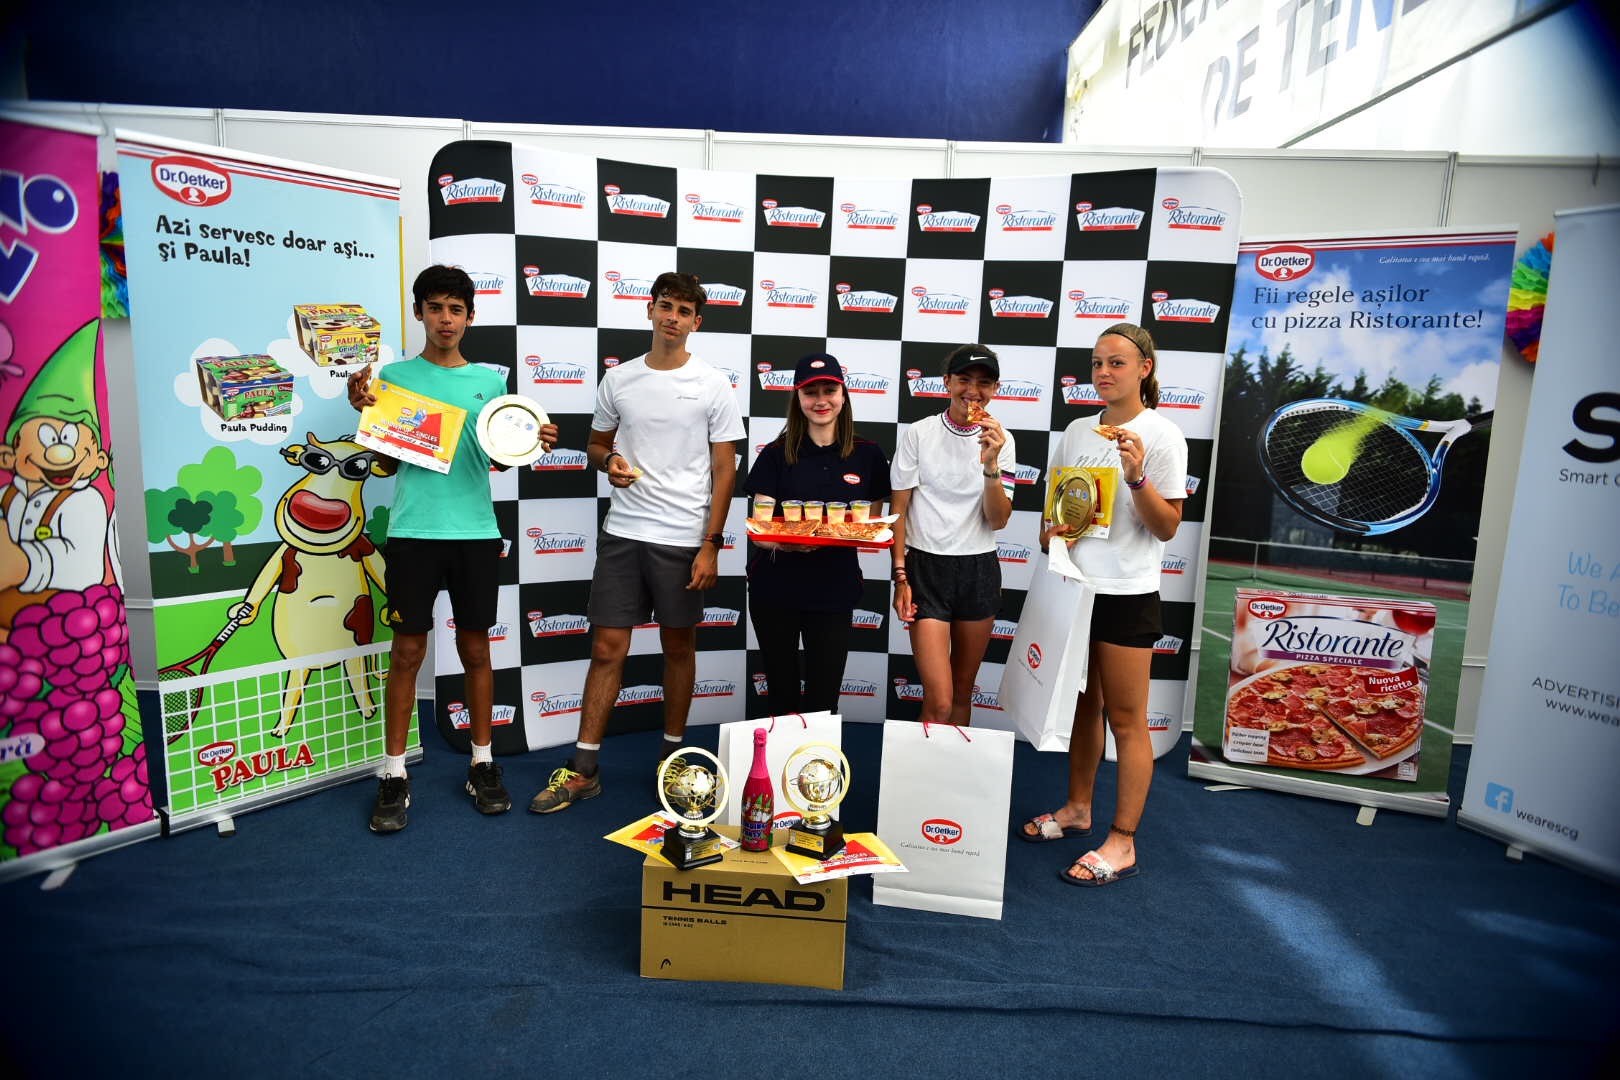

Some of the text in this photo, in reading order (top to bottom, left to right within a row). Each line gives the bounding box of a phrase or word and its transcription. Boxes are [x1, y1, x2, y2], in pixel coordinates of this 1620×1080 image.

[160, 168, 226, 190] Dr.Oetker
[445, 182, 502, 200] Ristorante
[529, 184, 586, 204] Ristorante
[611, 194, 667, 213] Ristorante
[691, 202, 744, 219] Ristorante
[768, 207, 822, 223] Ristorante
[846, 211, 899, 226] Ristorante
[921, 213, 976, 228] Ristorante
[1000, 213, 1056, 229] Ristorante
[1081, 211, 1140, 226] Ristorante
[1167, 209, 1226, 226] Ristorante
[156, 214, 191, 236] Azi
[199, 223, 276, 247] servesc
[282, 229, 327, 253] doar
[184, 242, 251, 267] Paula!
[1260, 255, 1310, 268] Dr.Oetker
[529, 276, 586, 296] Ristorante
[612, 280, 652, 297] Ristora
[706, 287, 743, 302] torante
[765, 288, 817, 304] Ristorante
[842, 291, 894, 308] Ristorante
[917, 295, 970, 312] Ristorante
[1254, 284, 1430, 309] Fii regele așilor
[994, 299, 1050, 316] Ristorante
[1074, 300, 1130, 314] Ristorante
[1157, 301, 1216, 318] Ristorante
[1251, 309, 1483, 333] cu pizza Ristorante!
[336, 337, 364, 345] PAULA
[532, 363, 586, 380] Ristorante
[763, 372, 795, 387] Ristor
[244, 389, 275, 399] PAULA
[912, 378, 950, 394] Ristora
[996, 383, 1042, 397] istorante
[1066, 384, 1098, 401] Ristor
[1158, 390, 1206, 405] istorante
[221, 423, 287, 433] Paula Pudding
[1559, 468, 1608, 486] Smart
[533, 535, 587, 551] Ristorante
[997, 546, 1030, 559] torante
[1568, 551, 1603, 578] We
[1558, 584, 1580, 610] To
[703, 611, 737, 622] torante
[533, 617, 589, 634] Ristorante
[1262, 619, 1404, 658] Ristorante
[1296, 653, 1363, 666] PIZZA SPECIALE
[841, 683, 877, 695] storante
[1368, 675, 1401, 687] Nuova
[1380, 680, 1413, 693] ricetta
[538, 698, 582, 713] Ristoran
[211, 743, 316, 793] PAULA
[1516, 807, 1580, 841] wearescg
[663, 881, 825, 912] HEAD
[663, 915, 695, 924] TENNIS
[697, 917, 727, 926] BALLS
